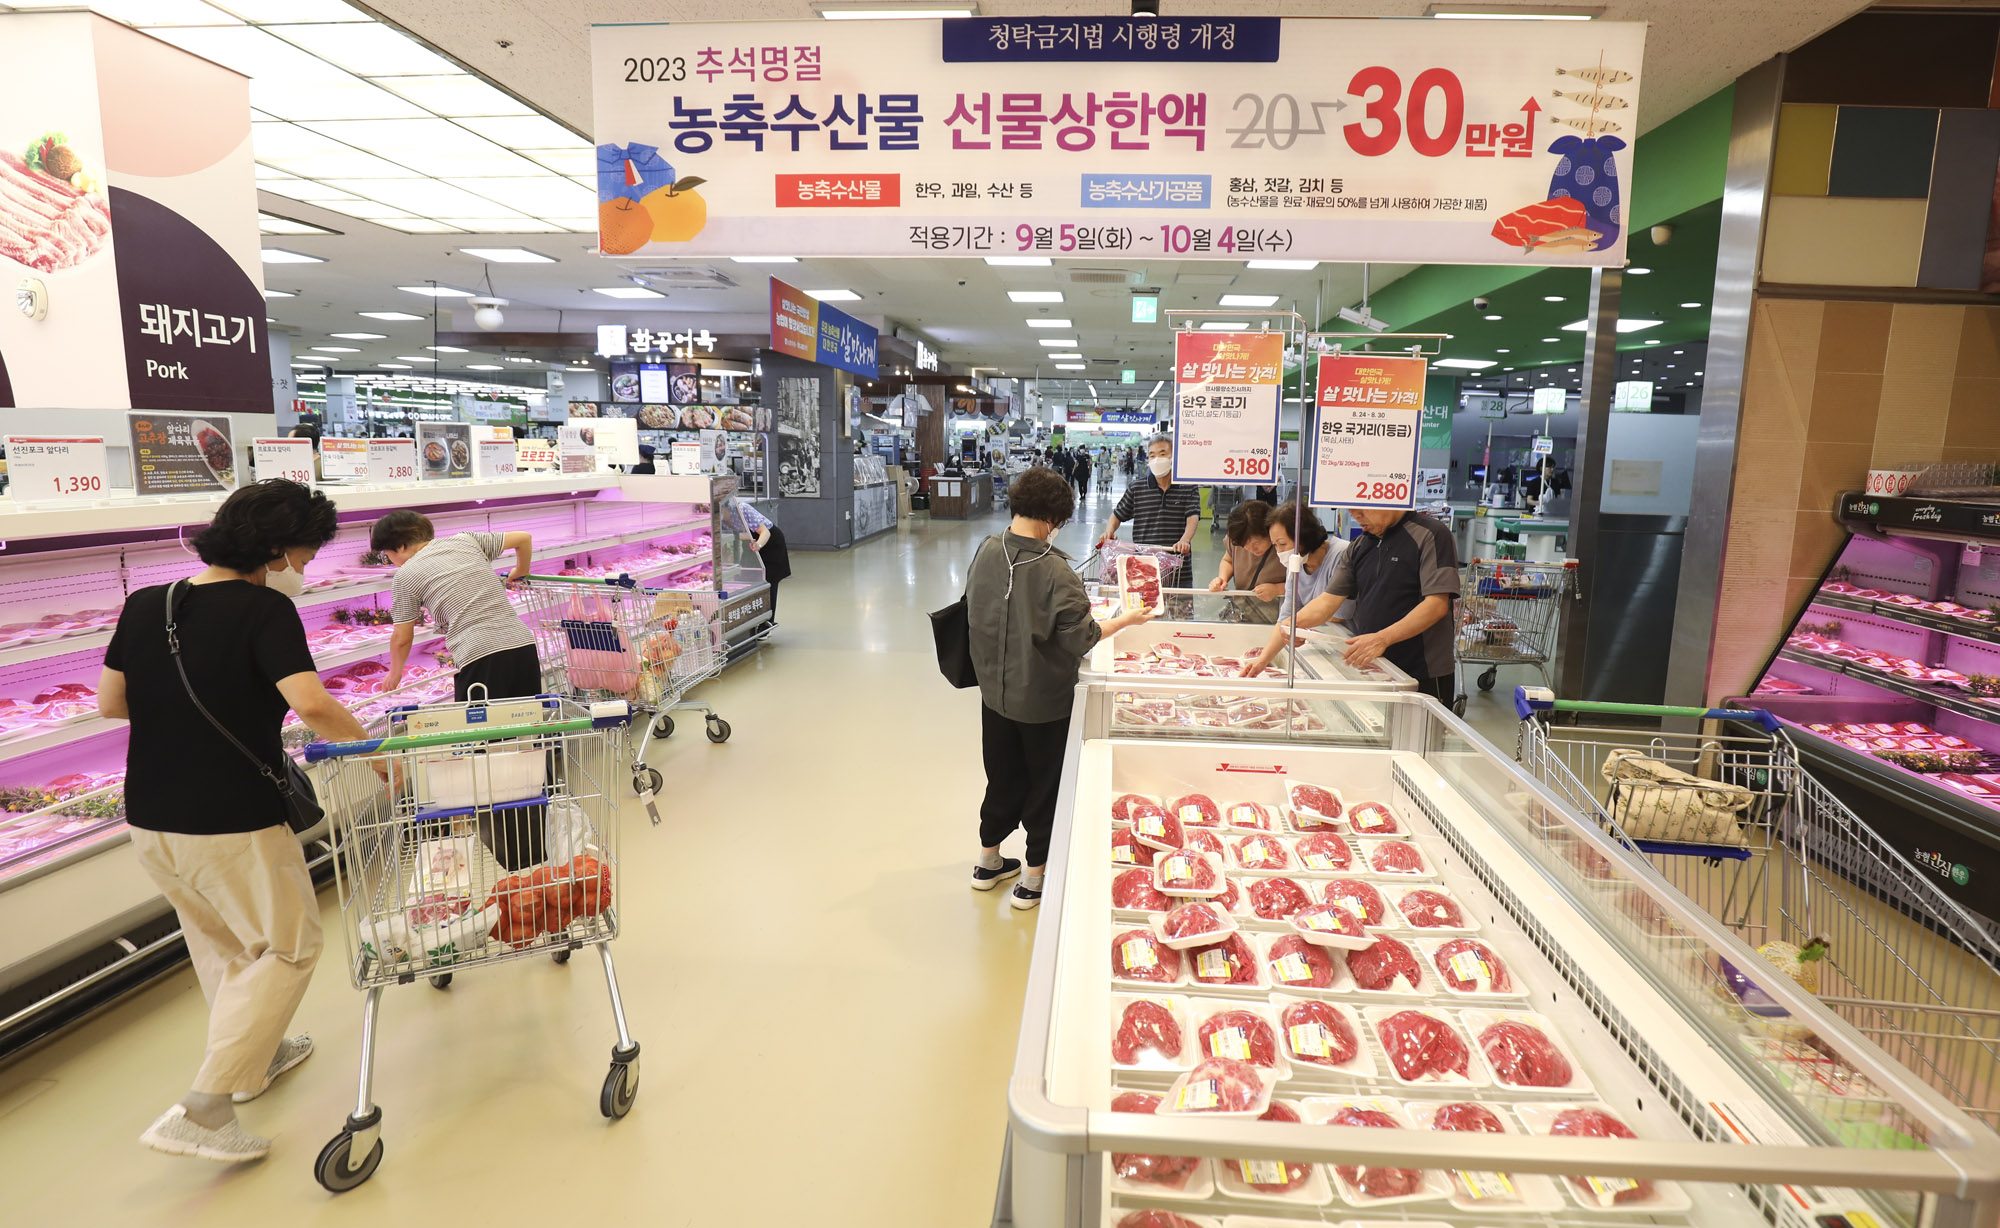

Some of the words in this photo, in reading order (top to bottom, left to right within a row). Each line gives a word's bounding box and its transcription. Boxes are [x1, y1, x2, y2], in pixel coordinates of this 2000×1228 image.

[988, 23, 1103, 52] 청탁금지법
[1112, 24, 1182, 50] 시행령
[1190, 24, 1236, 51] 개정
[624, 58, 686, 82] 2023
[696, 46, 822, 83] 추석명절
[668, 93, 923, 154] 농축수산물
[943, 91, 1206, 151] 선물상한액
[1342, 66, 1464, 157] 30
[798, 180, 881, 200] 농축수산물
[916, 182, 945, 199] 한우,
[951, 182, 981, 199] 과일,
[987, 182, 1014, 199] 수산
[1020, 183, 1033, 199] 등
[1089, 180, 1203, 202] 농축수산가공품
[1229, 177, 1258, 194] 홍삼,
[1264, 178, 1293, 194] 젓갈,
[1299, 178, 1324, 194] 김치
[1331, 178, 1344, 194] 등
[1227, 196, 1279, 208] (농수산물을
[1283, 196, 1335, 209] 원료·재료의
[1337, 197, 1367, 209] 50%를
[1369, 197, 1390, 210] 넘게
[1391, 197, 1431, 211] 사용하여
[1432, 198, 1462, 211] 가공한
[1464, 198, 1488, 211] 제품)
[909, 226, 994, 250] 적용기간
[1015, 224, 1053, 252] 9월
[1059, 224, 1133, 251] 5일(화)
[1160, 225, 1211, 253] 10월
[1217, 226, 1293, 253] 4일(수)
[139, 303, 256, 353] 돼지고기
[145, 359, 189, 380] Pork
[1182, 362, 1199, 379] 살
[1201, 363, 1246, 379] 맛나는
[1249, 365, 1277, 380] 가격!
[1354, 367, 1384, 376] 대한민국
[1322, 386, 1340, 402] 살
[1341, 387, 1388, 404] 맛나는
[1390, 391, 1419, 405] 가격!
[1549, 392, 1563, 404] 27
[1630, 386, 1649, 400] 26
[1182, 396, 1207, 409] 한우
[1210, 396, 1247, 410] 불고기
[1490, 400, 1503, 411] 28
[1422, 405, 1449, 420] 산대
[166, 423, 190, 435] 앞다리
[1322, 422, 1343, 435] 한우
[1345, 422, 1412, 438] 국거리(1등급)
[138, 431, 166, 445] 고추장
[12, 446, 44, 454] 선진포크
[46, 446, 70, 455] 앞다리
[520, 451, 555, 462] 프로포크
[354, 466, 368, 475] 800
[388, 466, 413, 479] 2,880
[495, 463, 514, 475] 1,480
[1223, 457, 1270, 476] 3,180
[281, 470, 310, 482] 1390
[53, 476, 101, 494] 1,390
[1355, 481, 1408, 501] 2,880
